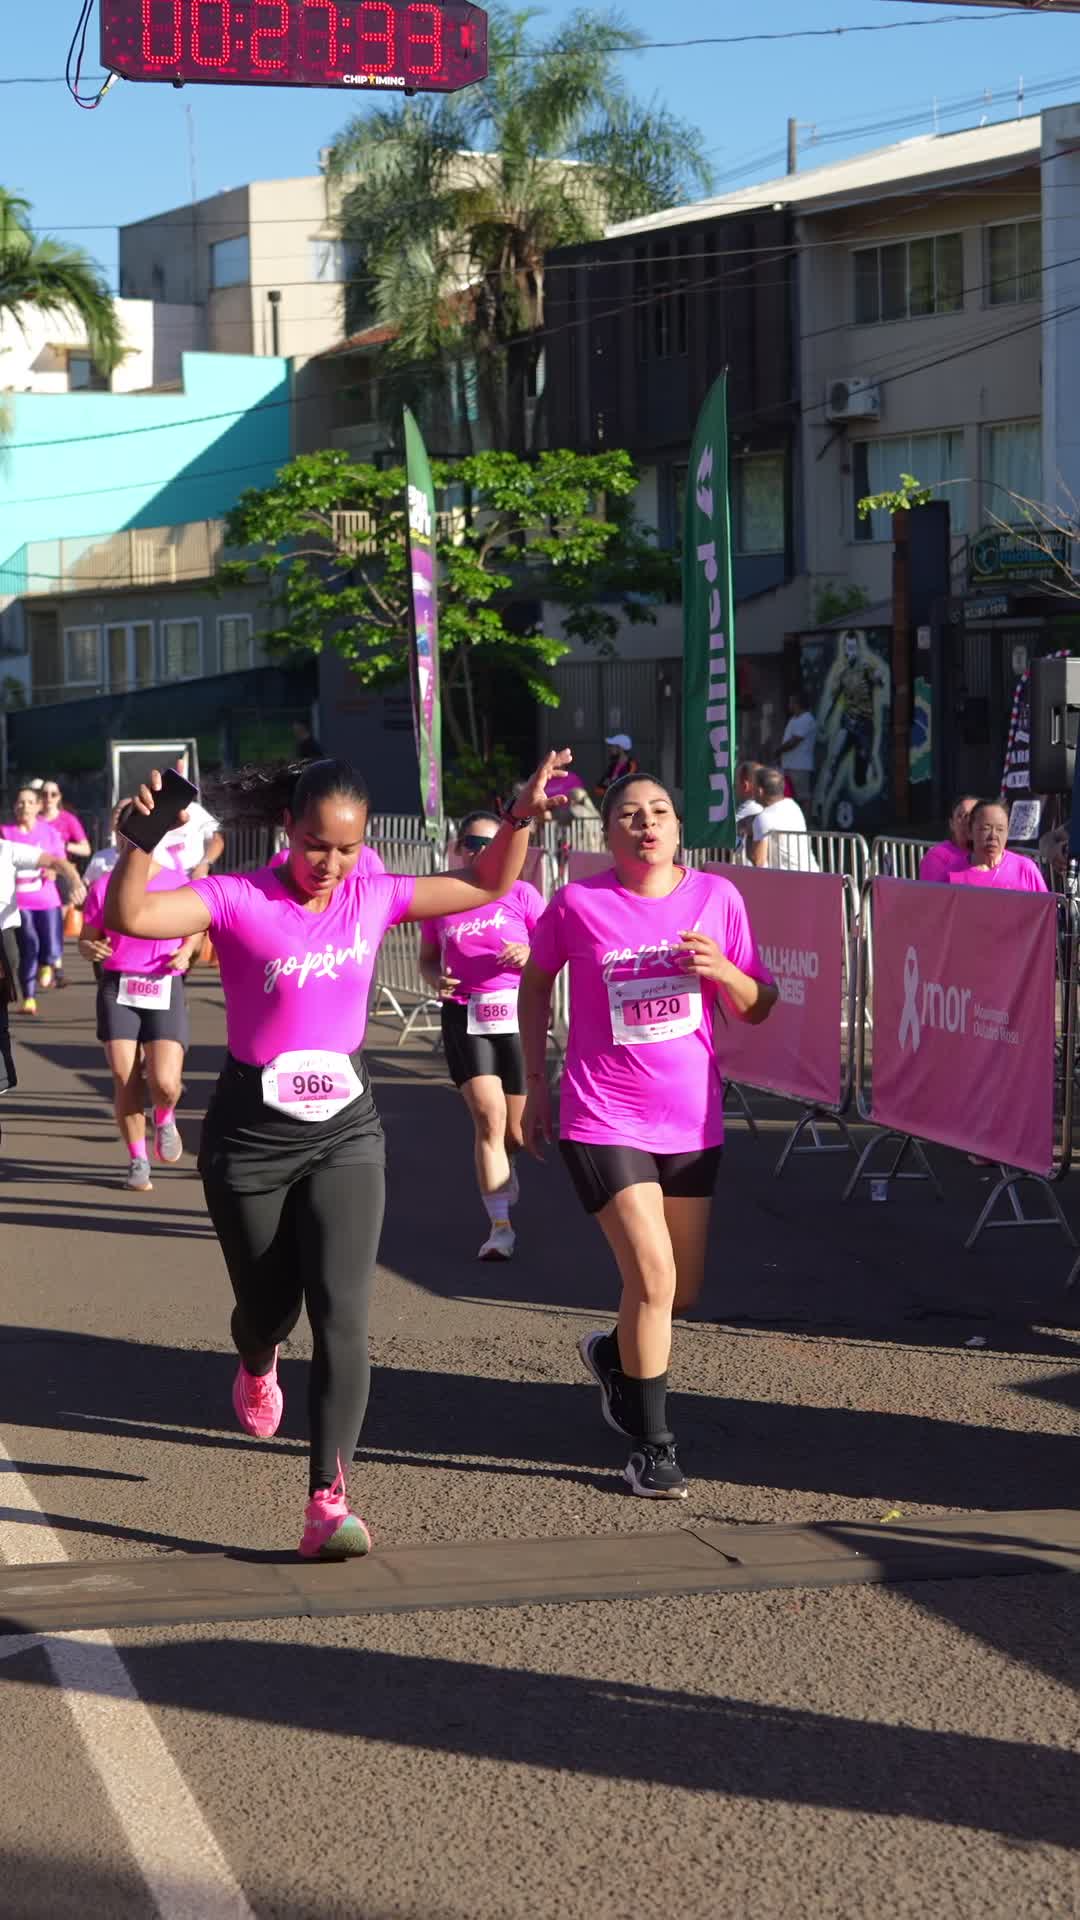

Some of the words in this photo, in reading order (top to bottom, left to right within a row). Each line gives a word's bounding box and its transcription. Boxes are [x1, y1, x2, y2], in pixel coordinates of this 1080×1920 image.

[263, 921, 371, 994] gopink
[132, 982, 160, 995] 1068
[483, 1004, 508, 1017] 586
[631, 998, 680, 1020] 1120
